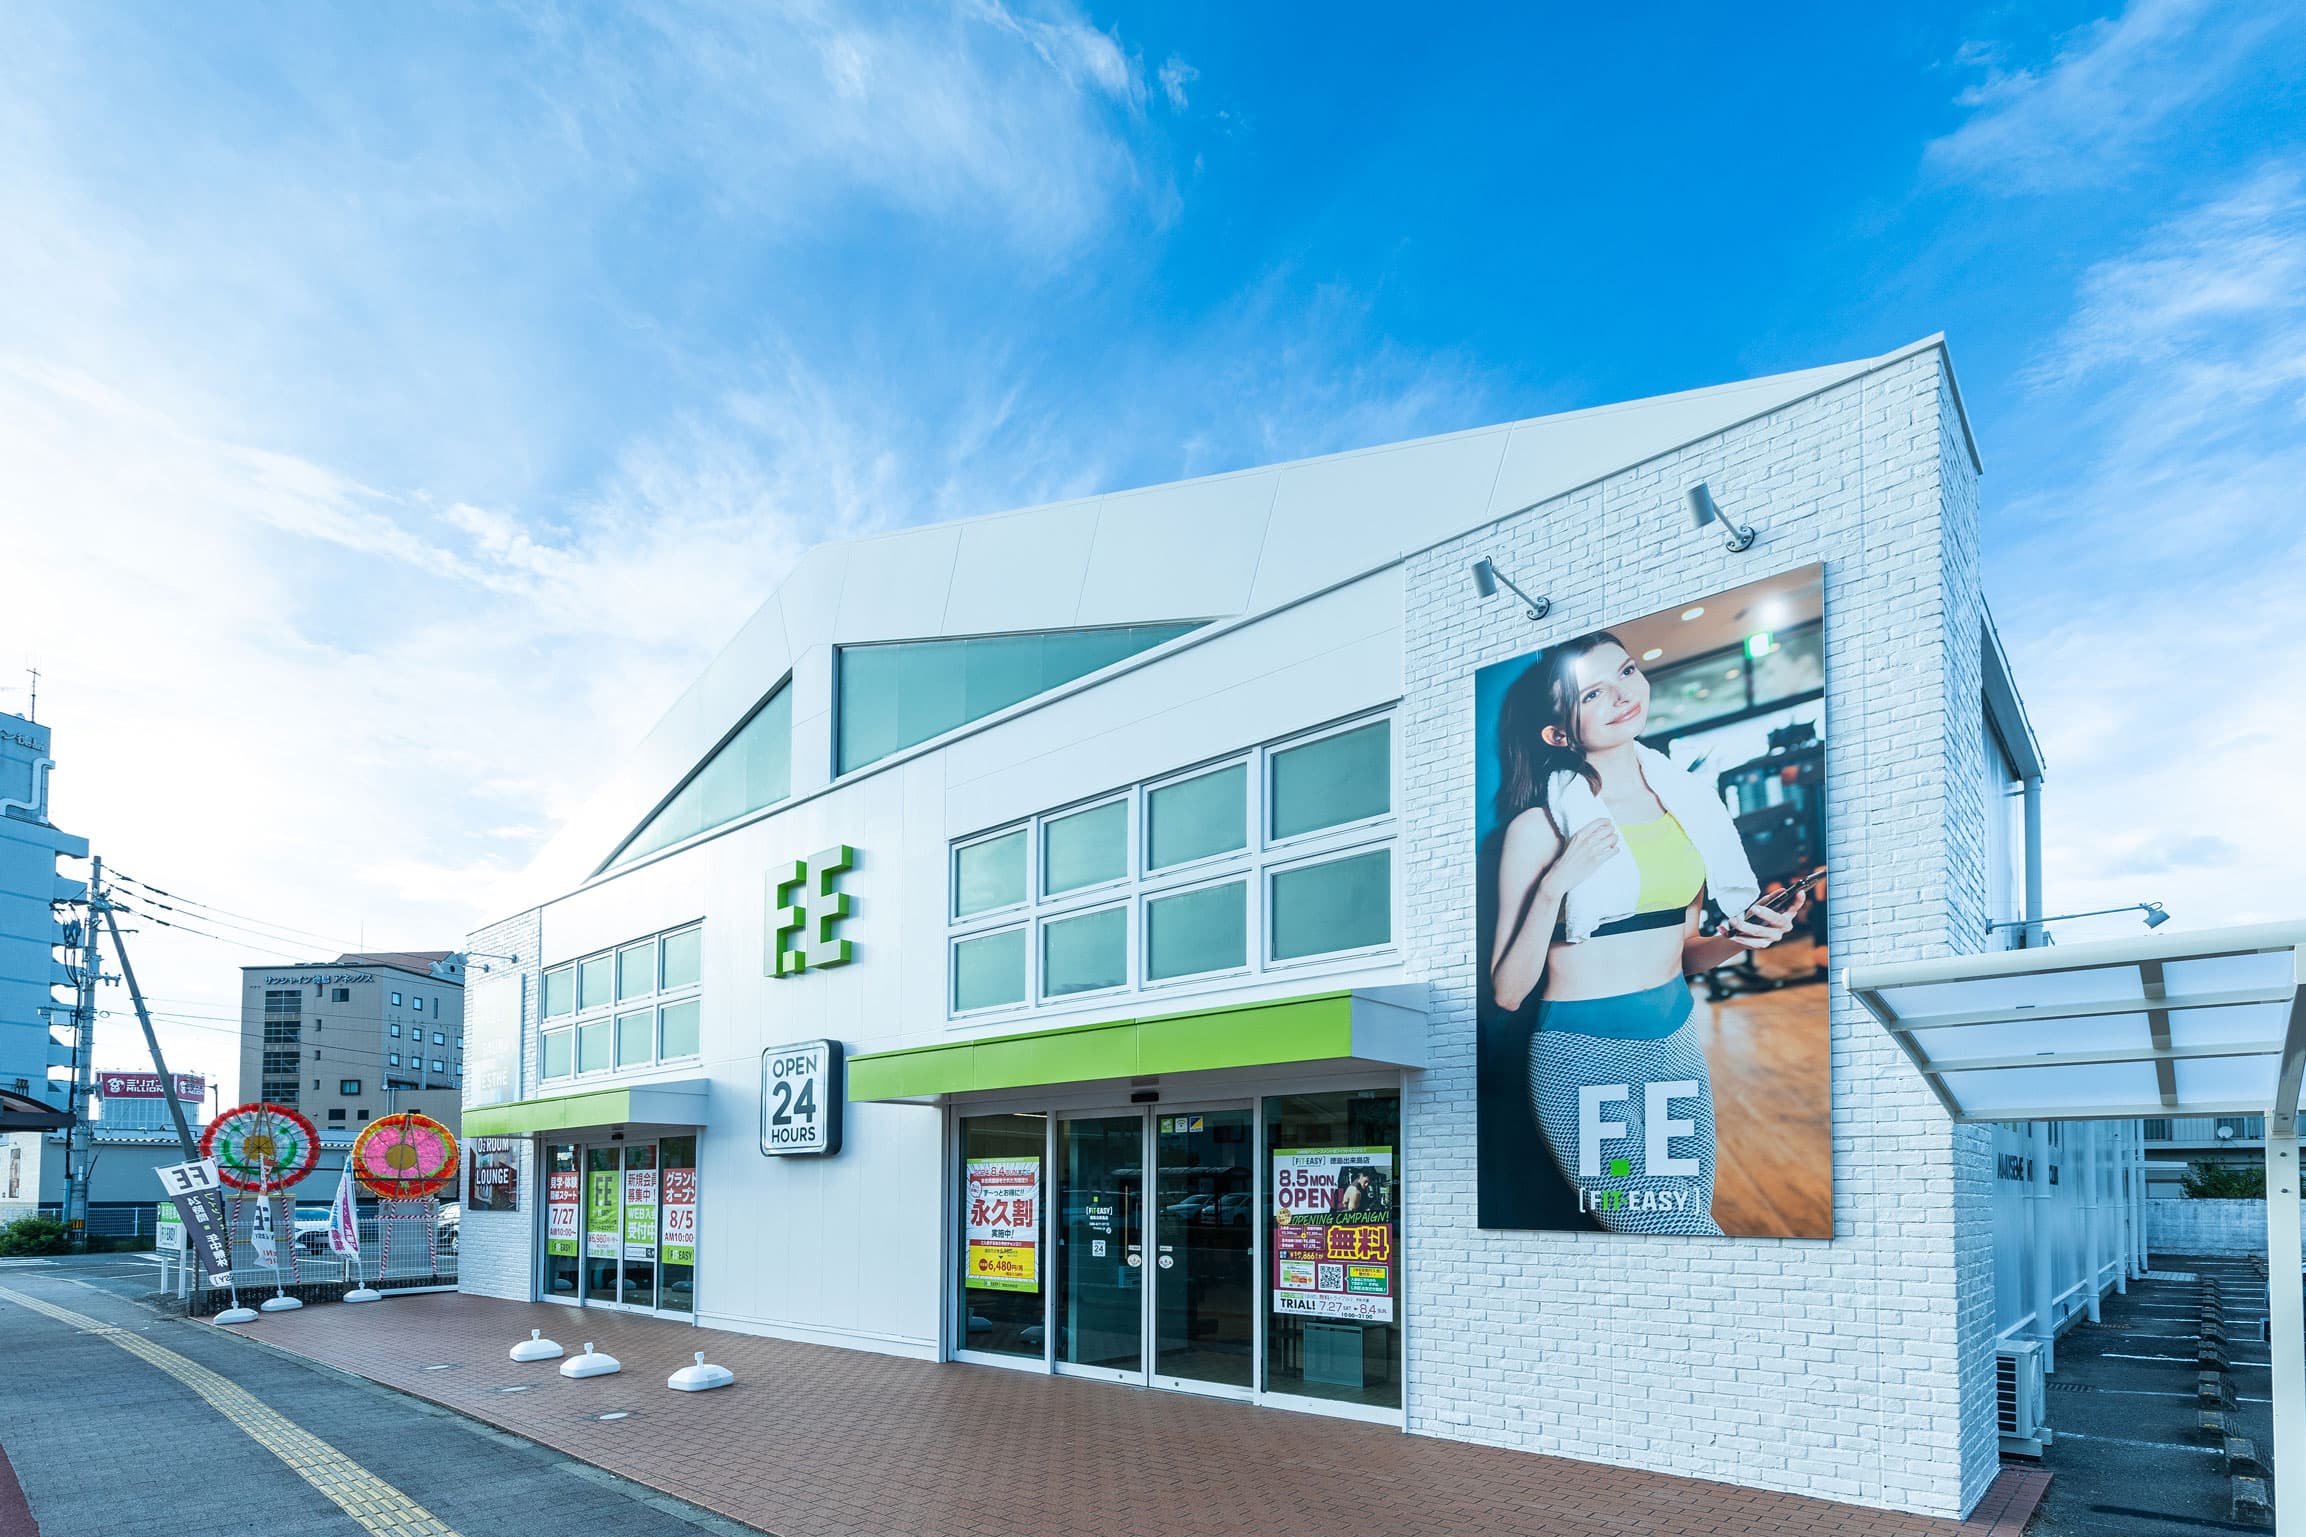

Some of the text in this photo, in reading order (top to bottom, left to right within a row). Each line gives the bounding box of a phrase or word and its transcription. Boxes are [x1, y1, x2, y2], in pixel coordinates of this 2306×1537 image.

[772, 1054, 818, 1079] OPEN
[772, 1078, 817, 1126] 24
[771, 1126, 817, 1144] HOURS
[476, 1168, 509, 1185] LOUNGE
[1279, 1169, 1337, 1187] 8.5 MON.
[552, 1208, 574, 1225] 7/27
[669, 1210, 694, 1230] 8/5
[970, 1198, 1033, 1228] 永久割
[1291, 1214, 1334, 1226] OPENING
[1335, 1211, 1390, 1225] CAMPAIGN!
[1094, 1244, 1104, 1252] 24
[1327, 1225, 1390, 1260] 無料
[1280, 1298, 1316, 1310] TRIAL!
[1320, 1301, 1342, 1312] 7.27
[1359, 1303, 1377, 1314] 8.4
